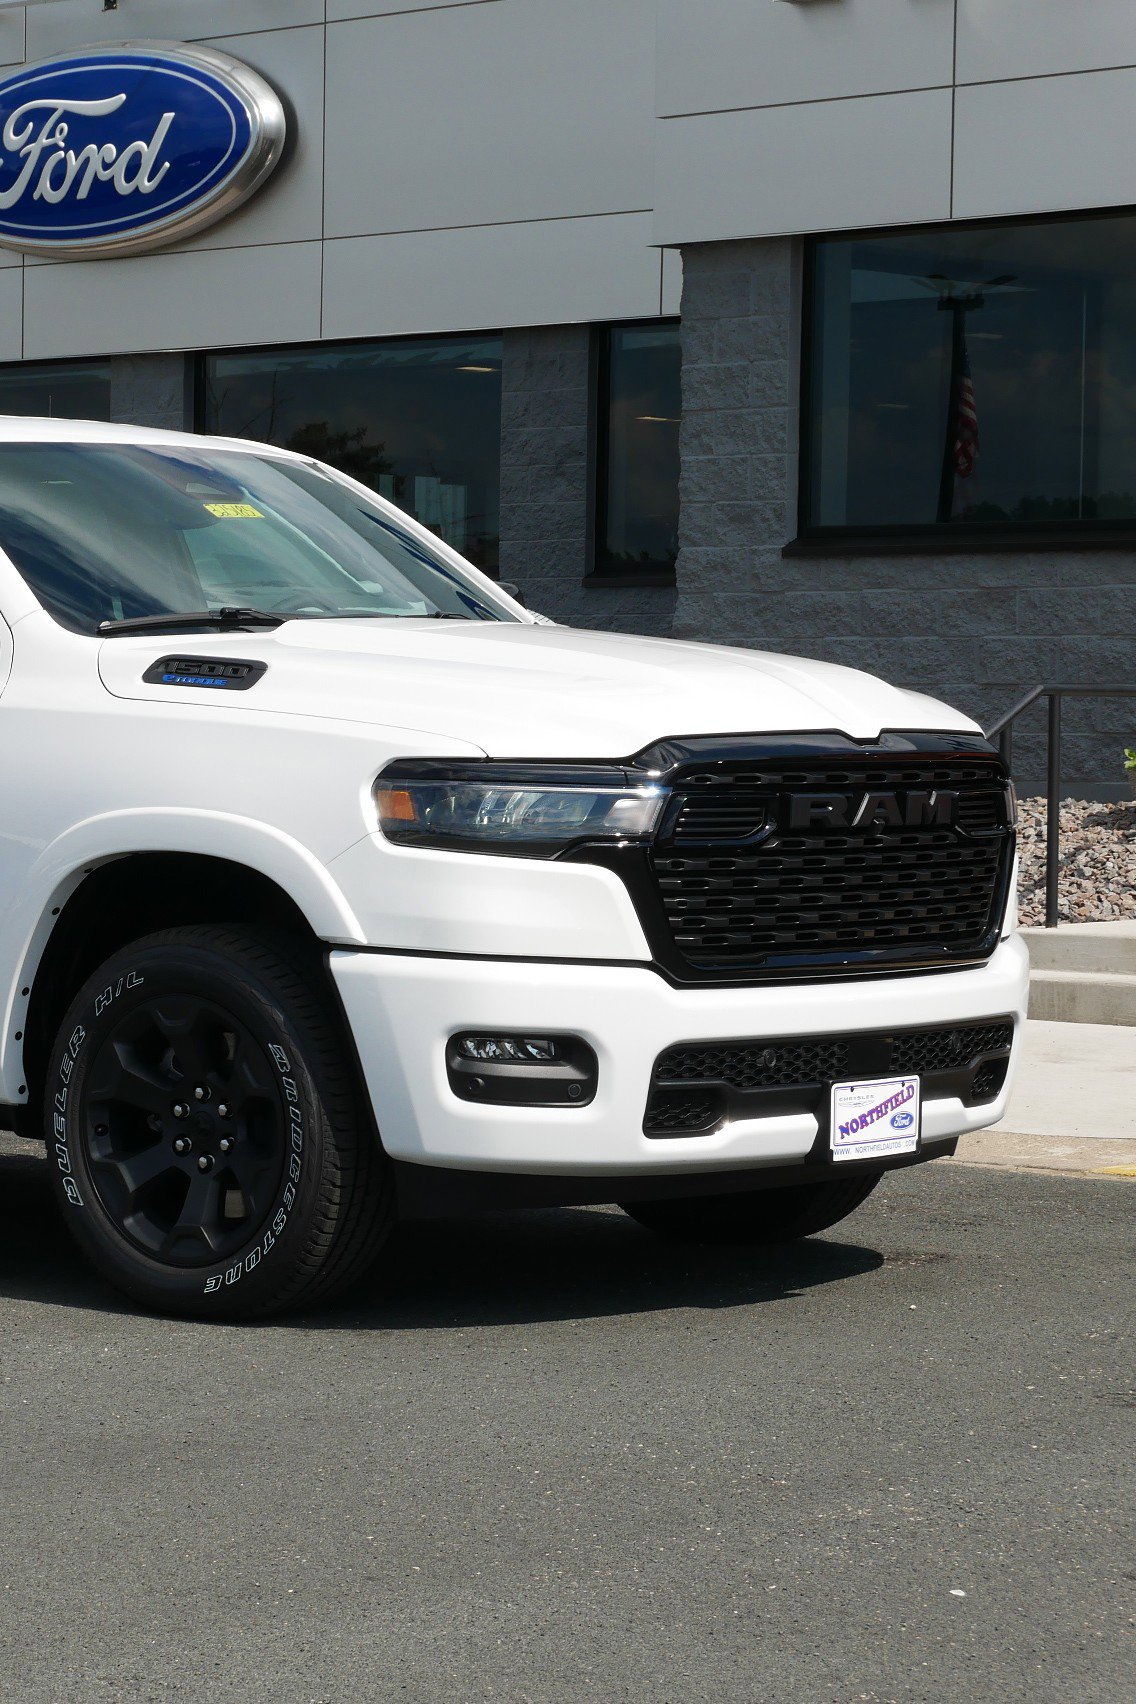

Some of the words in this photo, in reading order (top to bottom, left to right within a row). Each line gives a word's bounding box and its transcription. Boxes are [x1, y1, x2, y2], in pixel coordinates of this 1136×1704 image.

[156, 659, 250, 678] 1500
[789, 791, 954, 828] RAM
[53, 1025, 85, 1206] DUELER
[95, 971, 144, 1016] H/L
[838, 1084, 915, 1139] NORTHFIELD
[893, 1113, 911, 1127] Ford
[204, 1043, 304, 1293] BRIDGESTONE
